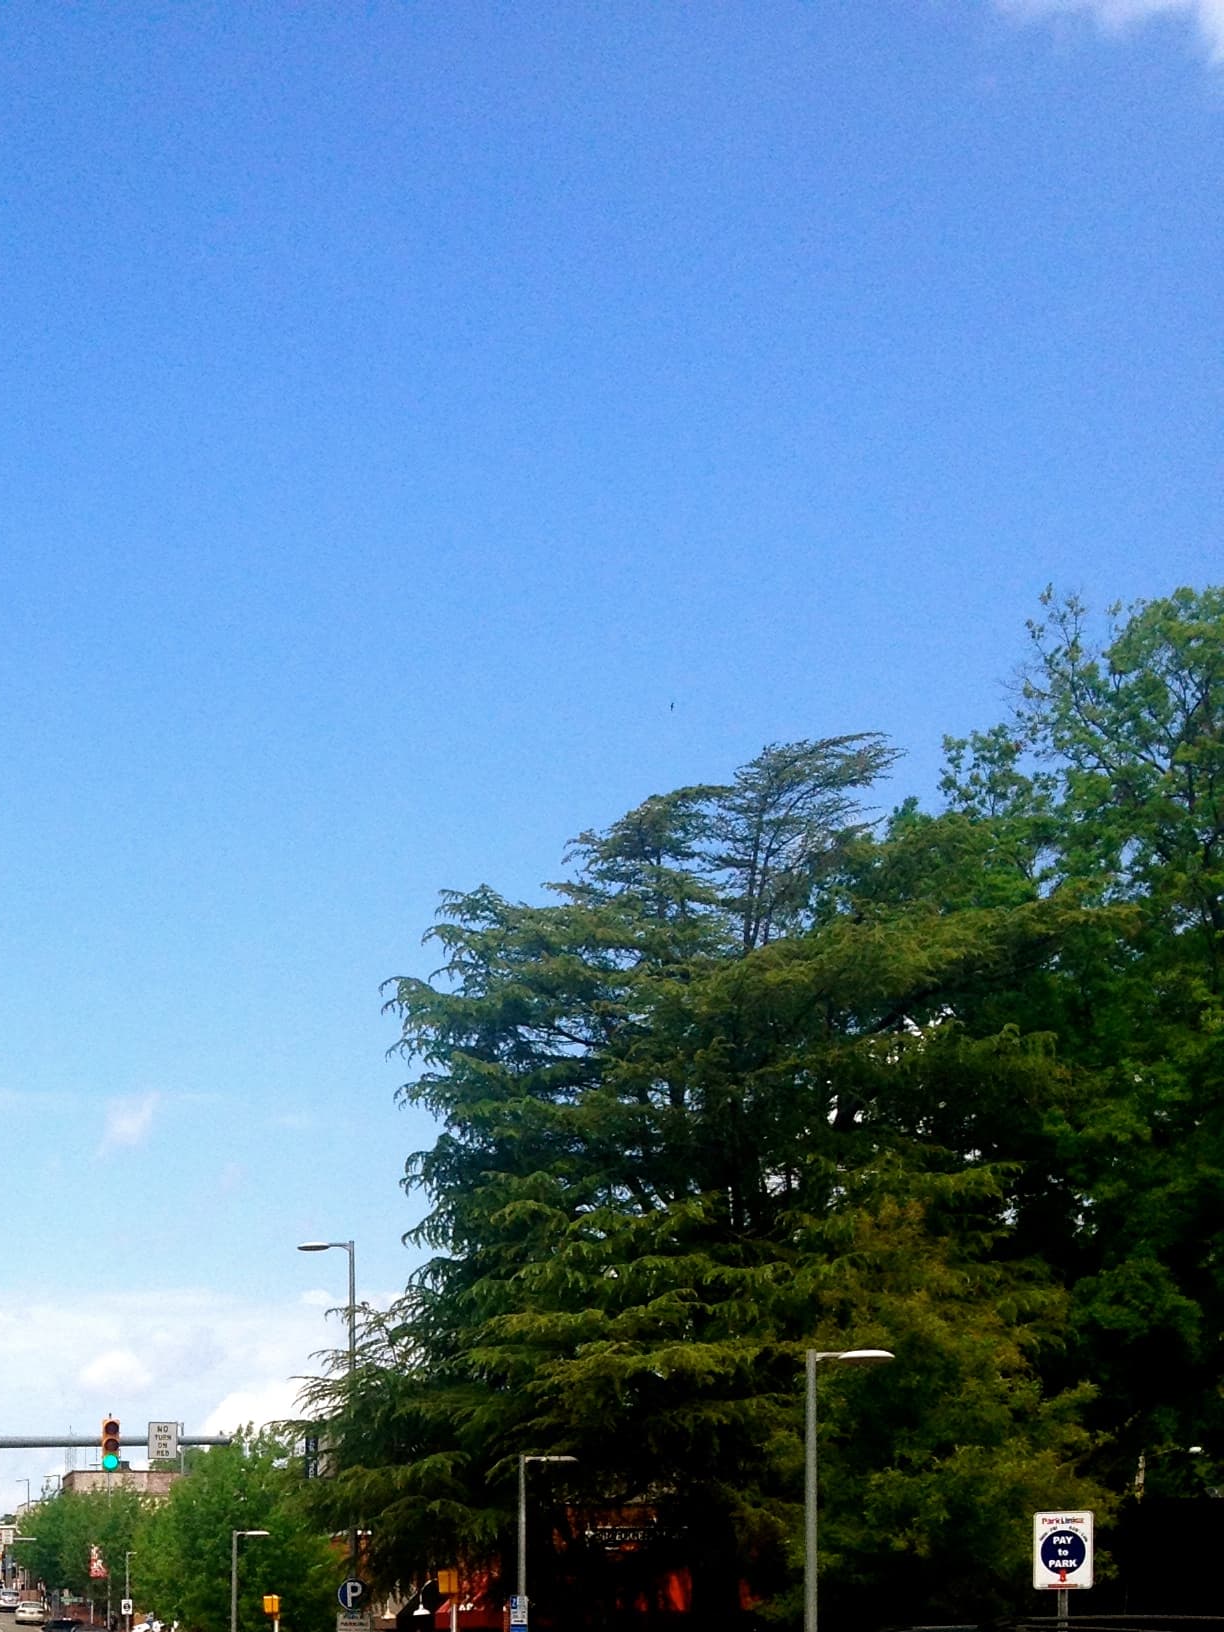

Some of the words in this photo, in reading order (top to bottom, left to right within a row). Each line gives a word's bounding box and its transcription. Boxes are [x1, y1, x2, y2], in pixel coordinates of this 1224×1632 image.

[157, 1425, 169, 1433] NO
[1052, 1536, 1074, 1545] PAY
[1057, 1548, 1069, 1556] to
[1048, 1559, 1077, 1568] PARK
[346, 1581, 363, 1608] P
